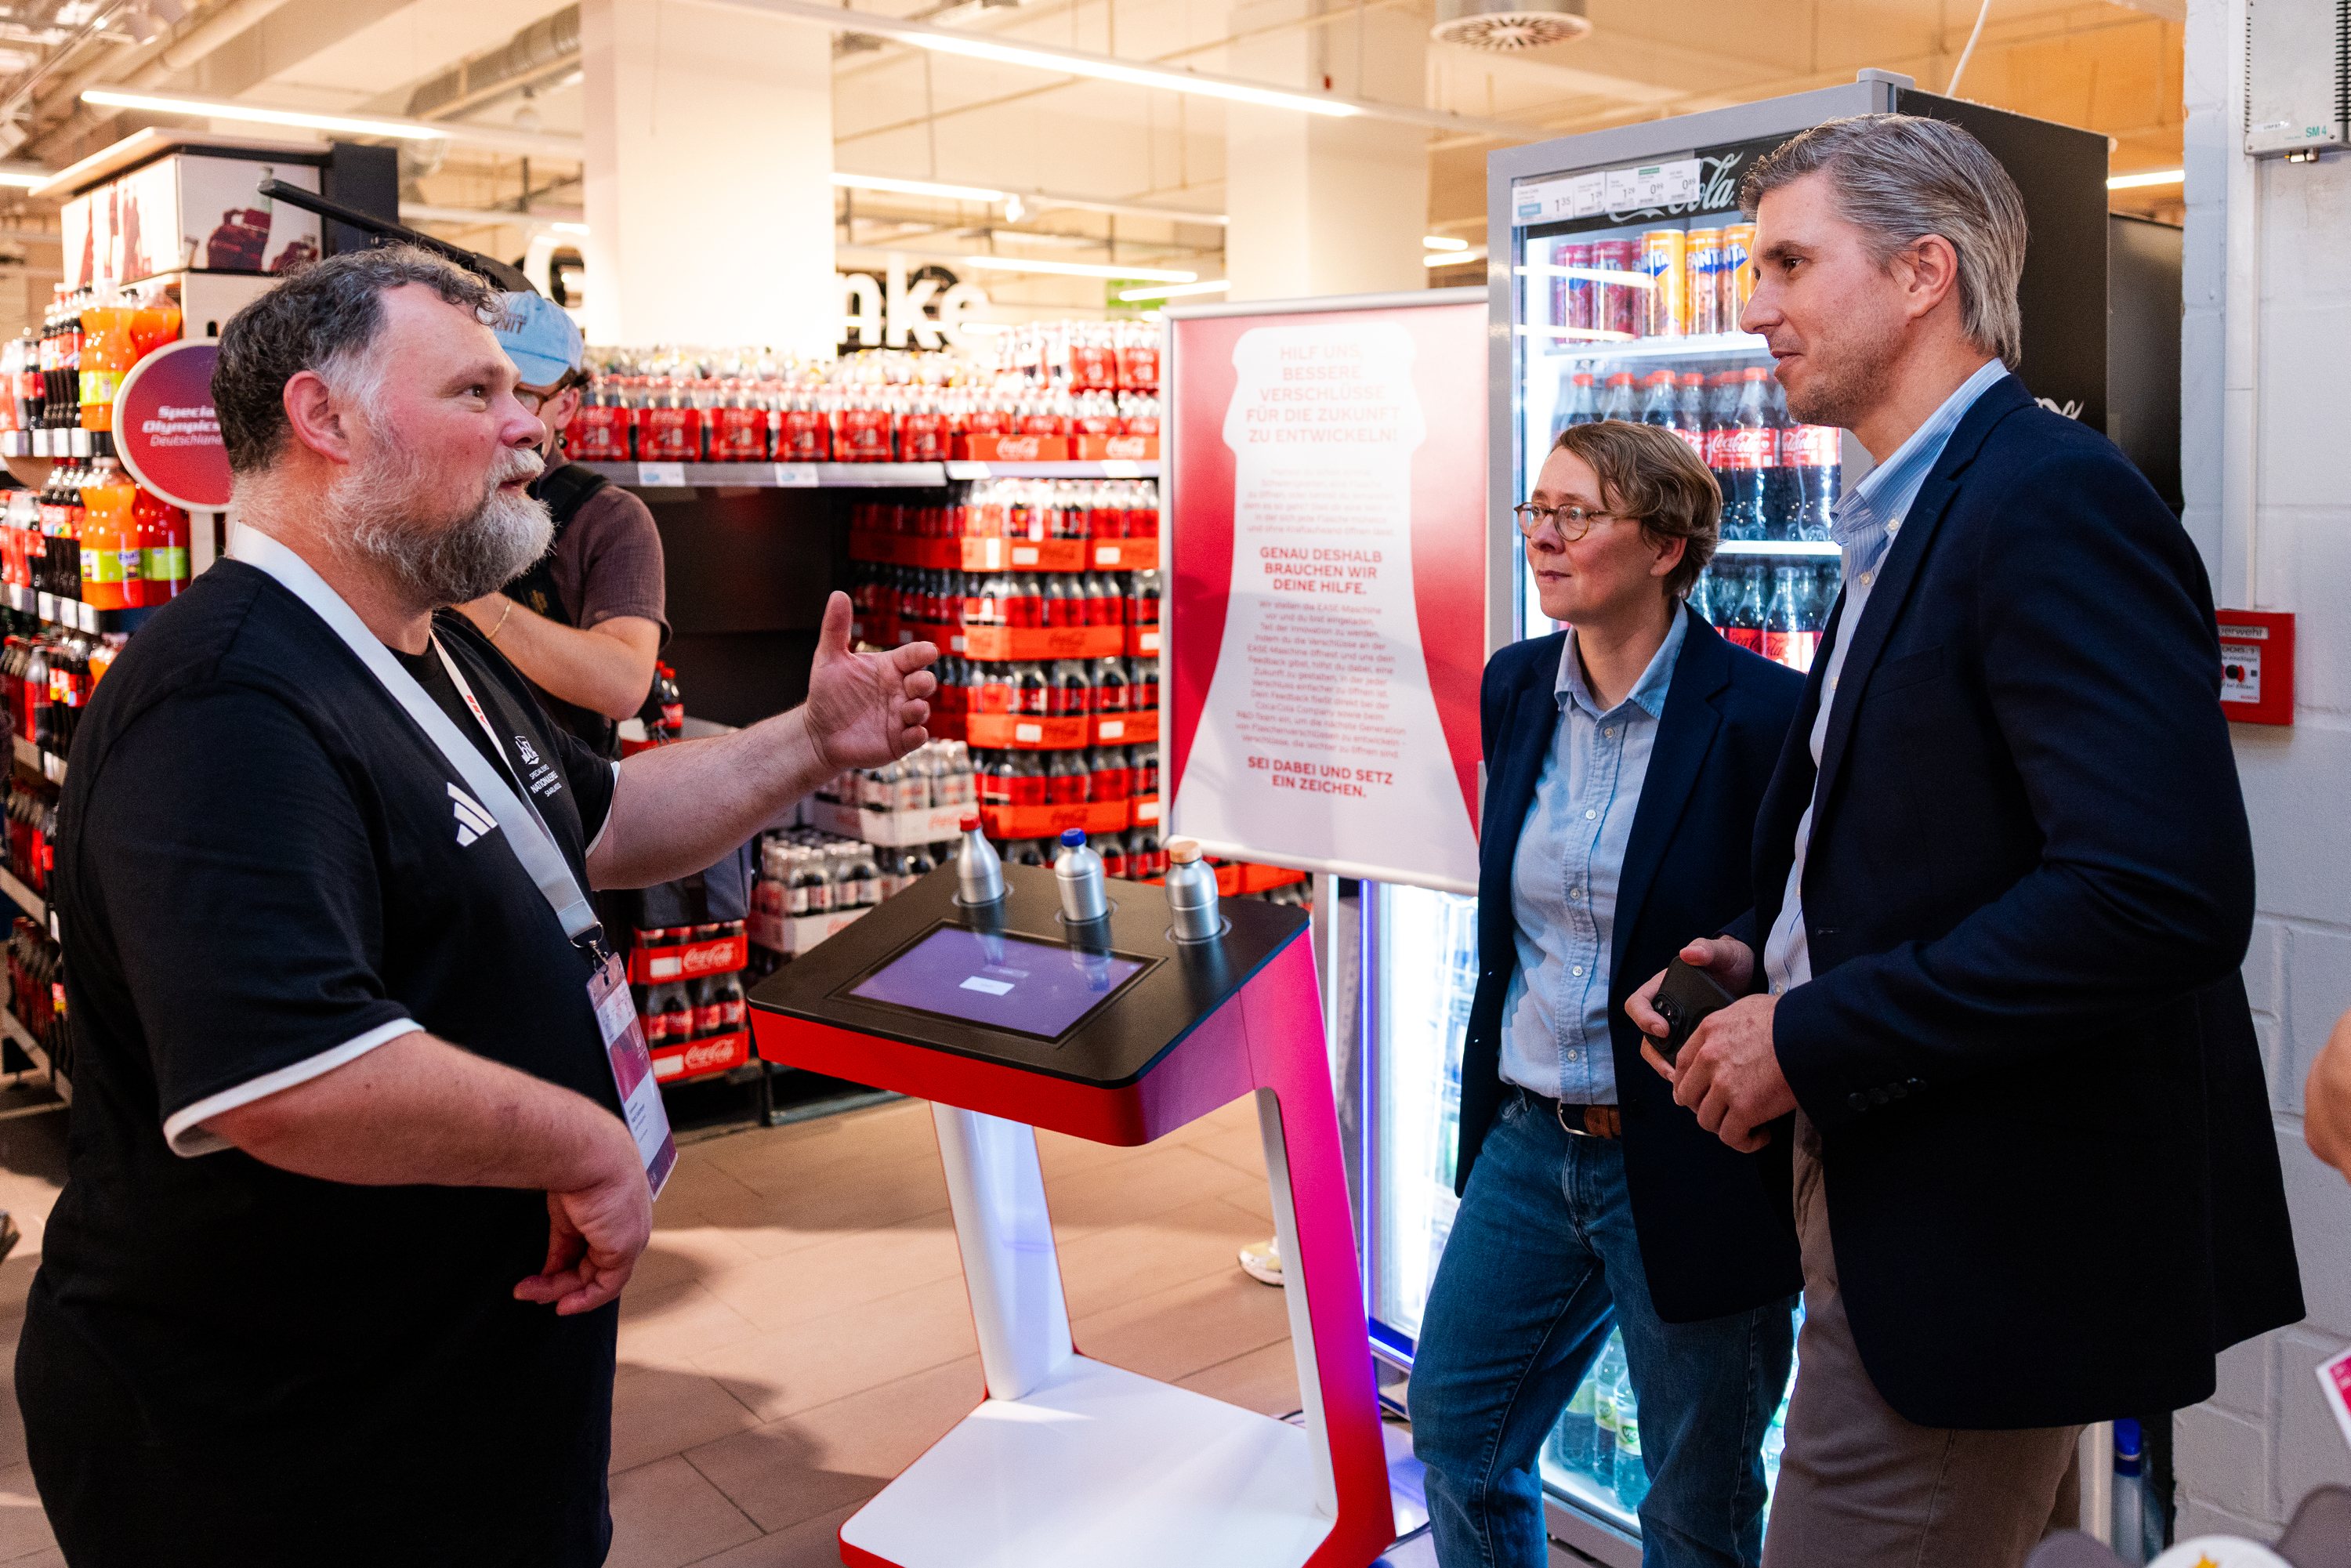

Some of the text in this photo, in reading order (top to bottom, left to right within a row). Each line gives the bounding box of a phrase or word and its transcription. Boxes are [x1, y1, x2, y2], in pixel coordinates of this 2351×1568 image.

[2306, 125, 2327, 138] SM 4
[1280, 344, 1364, 361] HILF UNS,
[1283, 365, 1361, 381] BESSERE
[1259, 382, 1386, 402] VERSCHLÜSSE
[158, 405, 216, 420] Specia
[1246, 404, 1400, 422] FÜR DIE ZUKUNFT
[142, 420, 221, 435] Olympics
[150, 433, 224, 447] Deutschland
[1248, 428, 1398, 444] ZU ENTWICKELN!
[1260, 547, 1382, 563] GENAU DESHALB
[1264, 563, 1377, 579] BRAUCHEN WIR
[1273, 578, 1367, 595] DEINE HILFE.
[1342, 606, 1382, 614] Maschine
[1260, 622, 1273, 631] Teil
[1291, 625, 1332, 635] Innovation
[1295, 636, 1306, 645] die
[1309, 638, 1357, 648] Verschlüsse
[1248, 644, 1266, 653] EASE
[1270, 646, 1307, 656] Maschine
[1310, 649, 1337, 658] öffnest
[1340, 651, 1357, 660] und
[1377, 654, 1395, 662] dein
[1248, 655, 1285, 665] Feedback
[1312, 660, 1332, 669] hilfst
[1375, 664, 1393, 674] eine
[1254, 668, 1284, 678] Zukunft
[1340, 673, 1348, 682] in
[1351, 673, 1363, 683] der
[1365, 675, 1387, 686] jeder
[1252, 679, 1294, 690] Verschluss
[1296, 683, 1333, 693] einfacher
[1348, 687, 1374, 697] öffnen
[1251, 690, 1389, 710] Dein Feedback fließt direkt bei der
[1297, 705, 1334, 717] Company
[1338, 708, 1361, 718] sowie
[1364, 711, 1385, 720] beim
[1257, 712, 1276, 722] Team
[1310, 717, 1321, 726] die
[1324, 719, 1357, 730] nächste
[1359, 722, 1406, 734] Generation
[1292, 740, 1304, 748] die
[1307, 741, 1336, 751] leichter
[1351, 745, 1378, 755] öffnen
[1353, 734, 1400, 746] entwickeln
[1248, 755, 1394, 785] SEI DABEI UND SETZ
[1272, 774, 1367, 797] EIN ZEICHEN.
